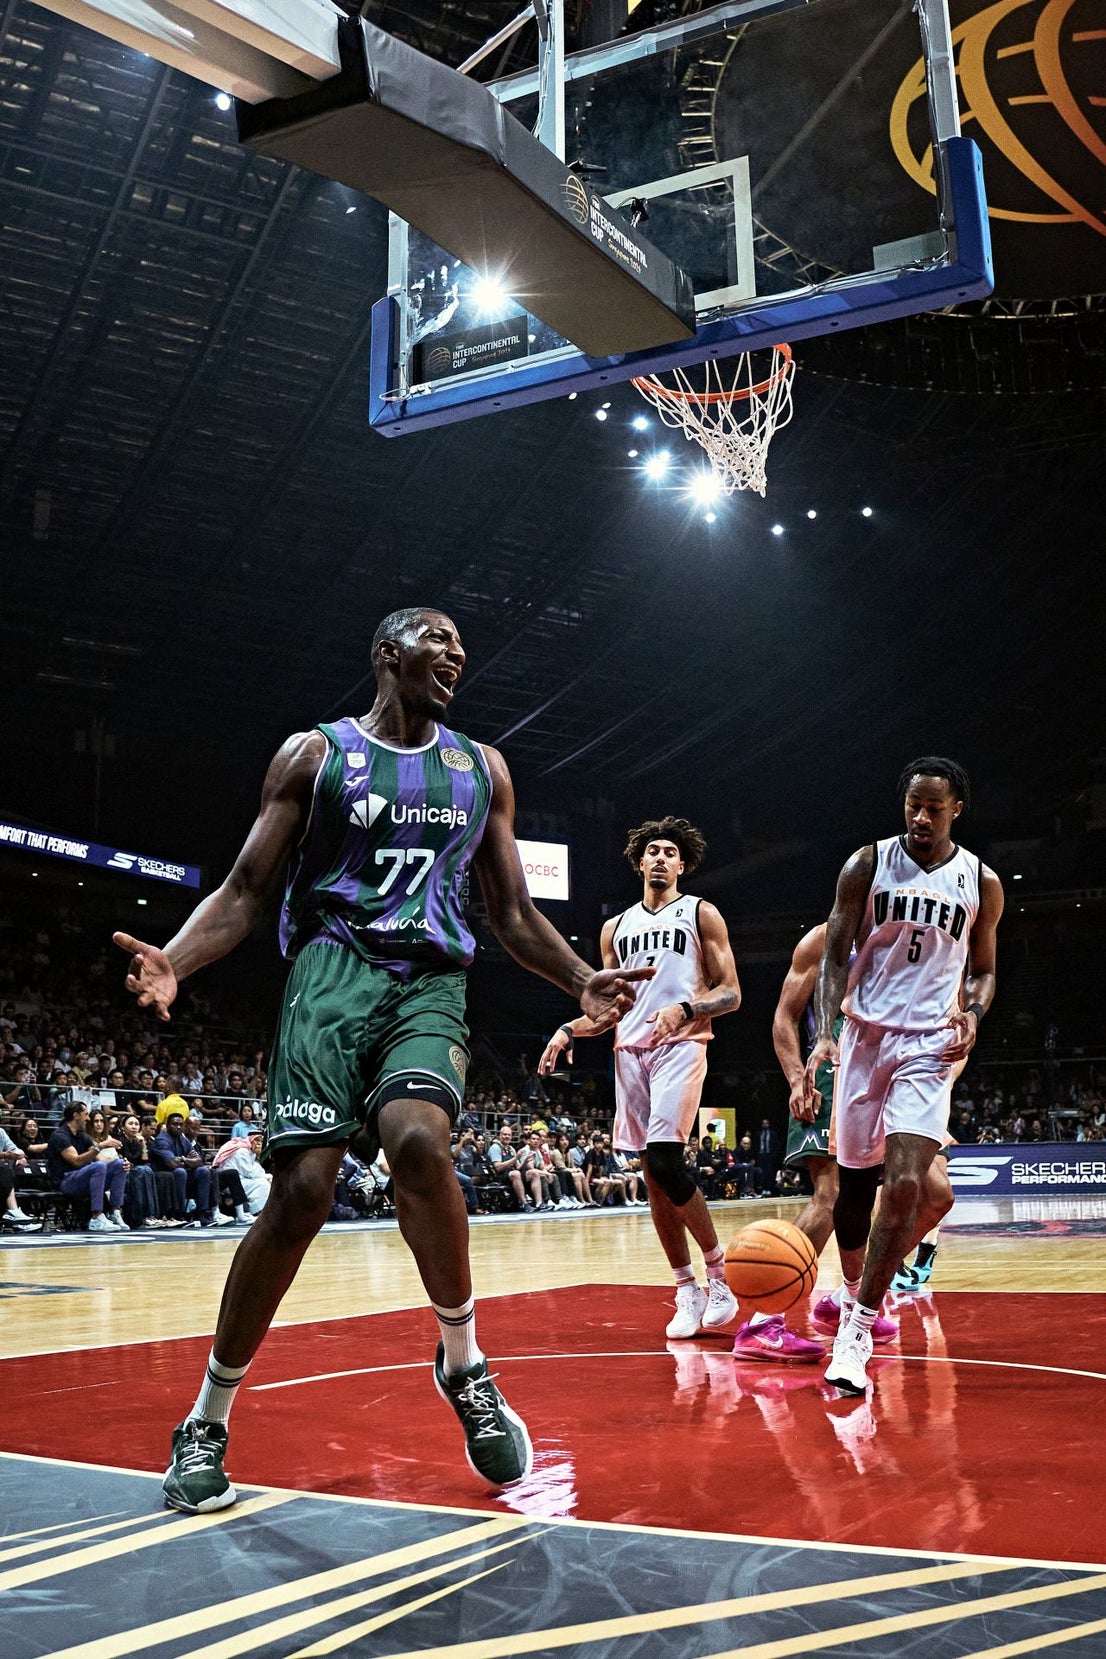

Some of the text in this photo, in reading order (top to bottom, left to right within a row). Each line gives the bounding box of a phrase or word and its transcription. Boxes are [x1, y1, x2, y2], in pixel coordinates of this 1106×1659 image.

[590, 205, 648, 268] INTERCONTINENTAL
[591, 221, 604, 242] CUP
[452, 335, 520, 360] INTERCONTINENTAL
[452, 358, 467, 369] CUP
[391, 803, 468, 830] Unicaja
[27, 831, 48, 849] THAT
[47, 836, 89, 859] PERFORMS
[138, 857, 185, 876] SKECHERS
[374, 848, 435, 896] 77
[525, 863, 559, 877] OCBC
[874, 890, 967, 942] UNITED
[618, 928, 687, 963] UNITED
[907, 930, 925, 964] 5
[1011, 1162, 1106, 1176] SKECHER
